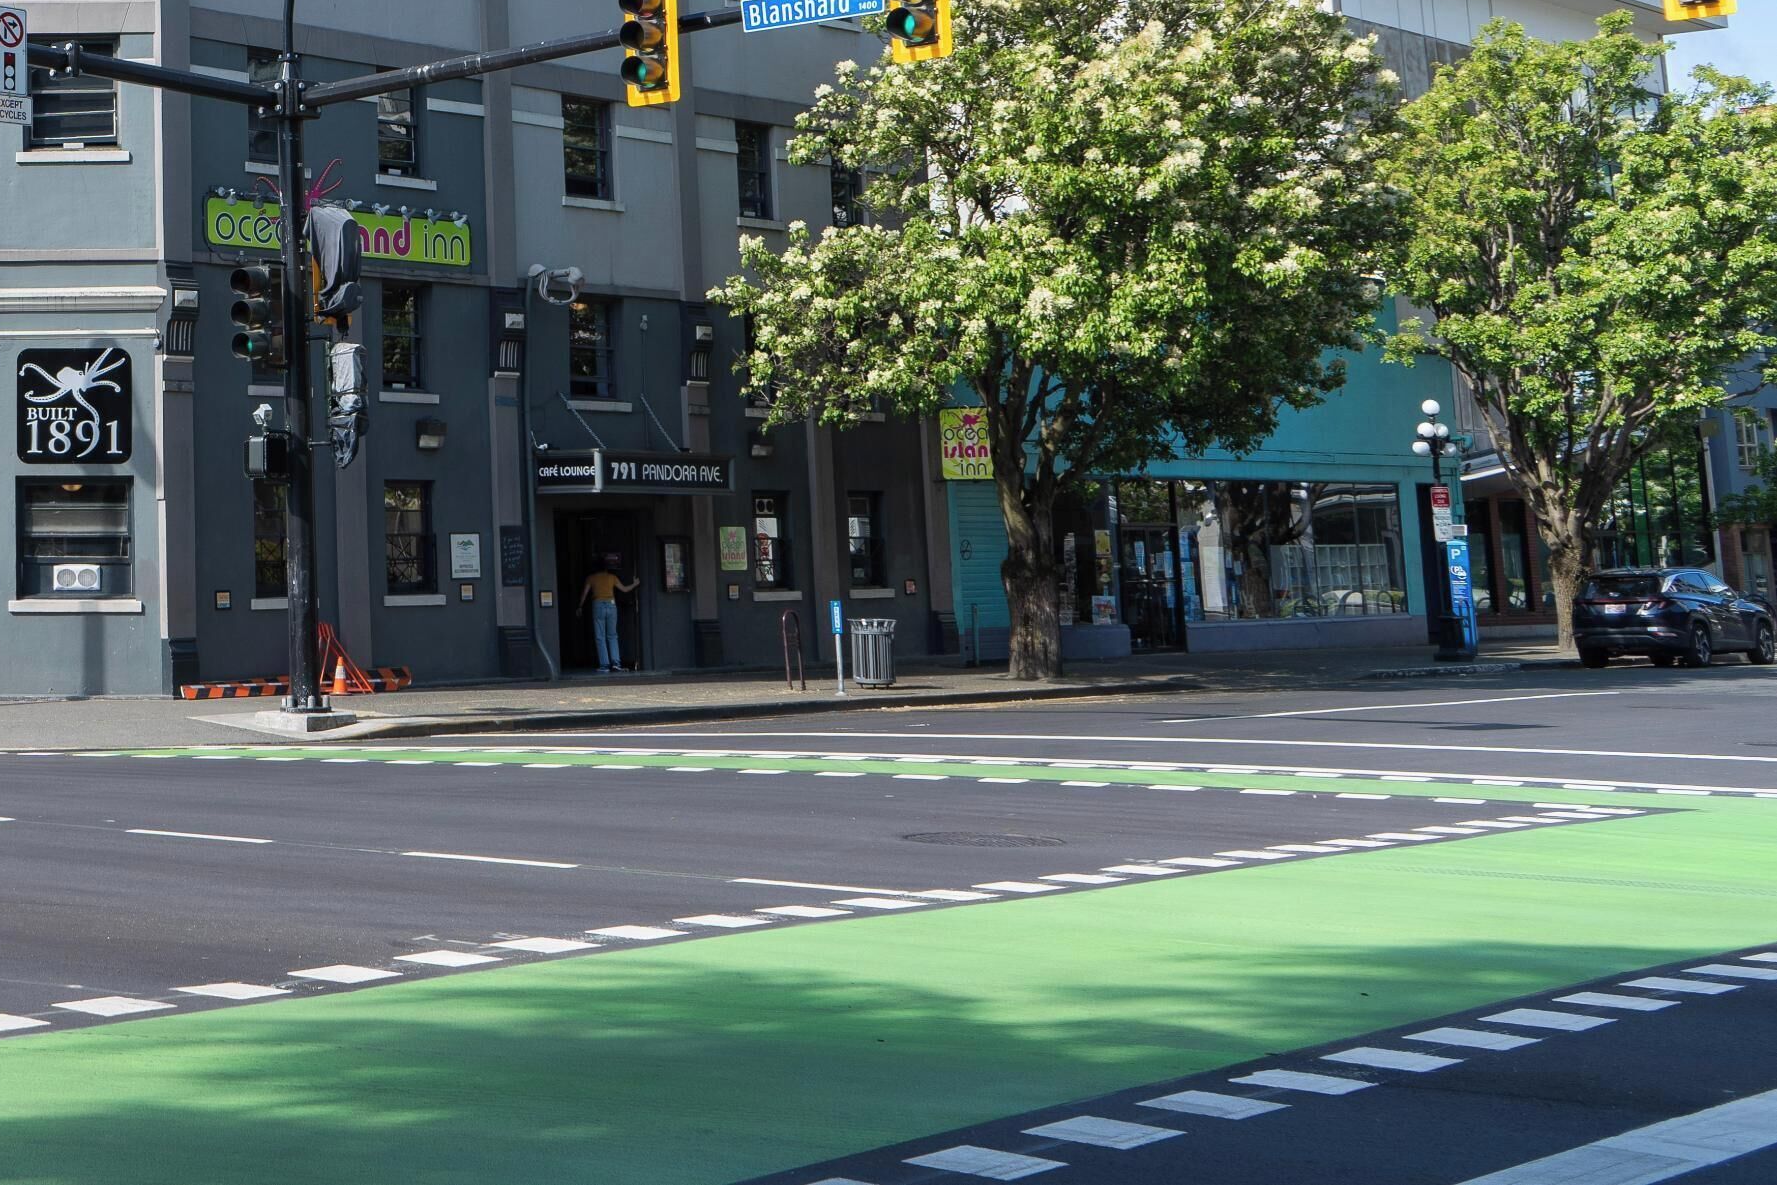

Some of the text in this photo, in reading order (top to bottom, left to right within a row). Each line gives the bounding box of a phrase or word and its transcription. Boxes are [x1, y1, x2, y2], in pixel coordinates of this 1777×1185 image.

[858, 0, 878, 11] 1400
[215, 212, 281, 245] oce
[423, 224, 466, 262] inn
[26, 407, 77, 421] BUILT
[26, 420, 123, 458] 1891
[943, 427, 988, 441] ocea
[943, 440, 989, 459] islan
[538, 464, 595, 477] CAFÉ LOUNGE
[611, 462, 723, 483] 791 PANDORA AVE.
[960, 459, 987, 476] inn
[1451, 548, 1462, 560] P
